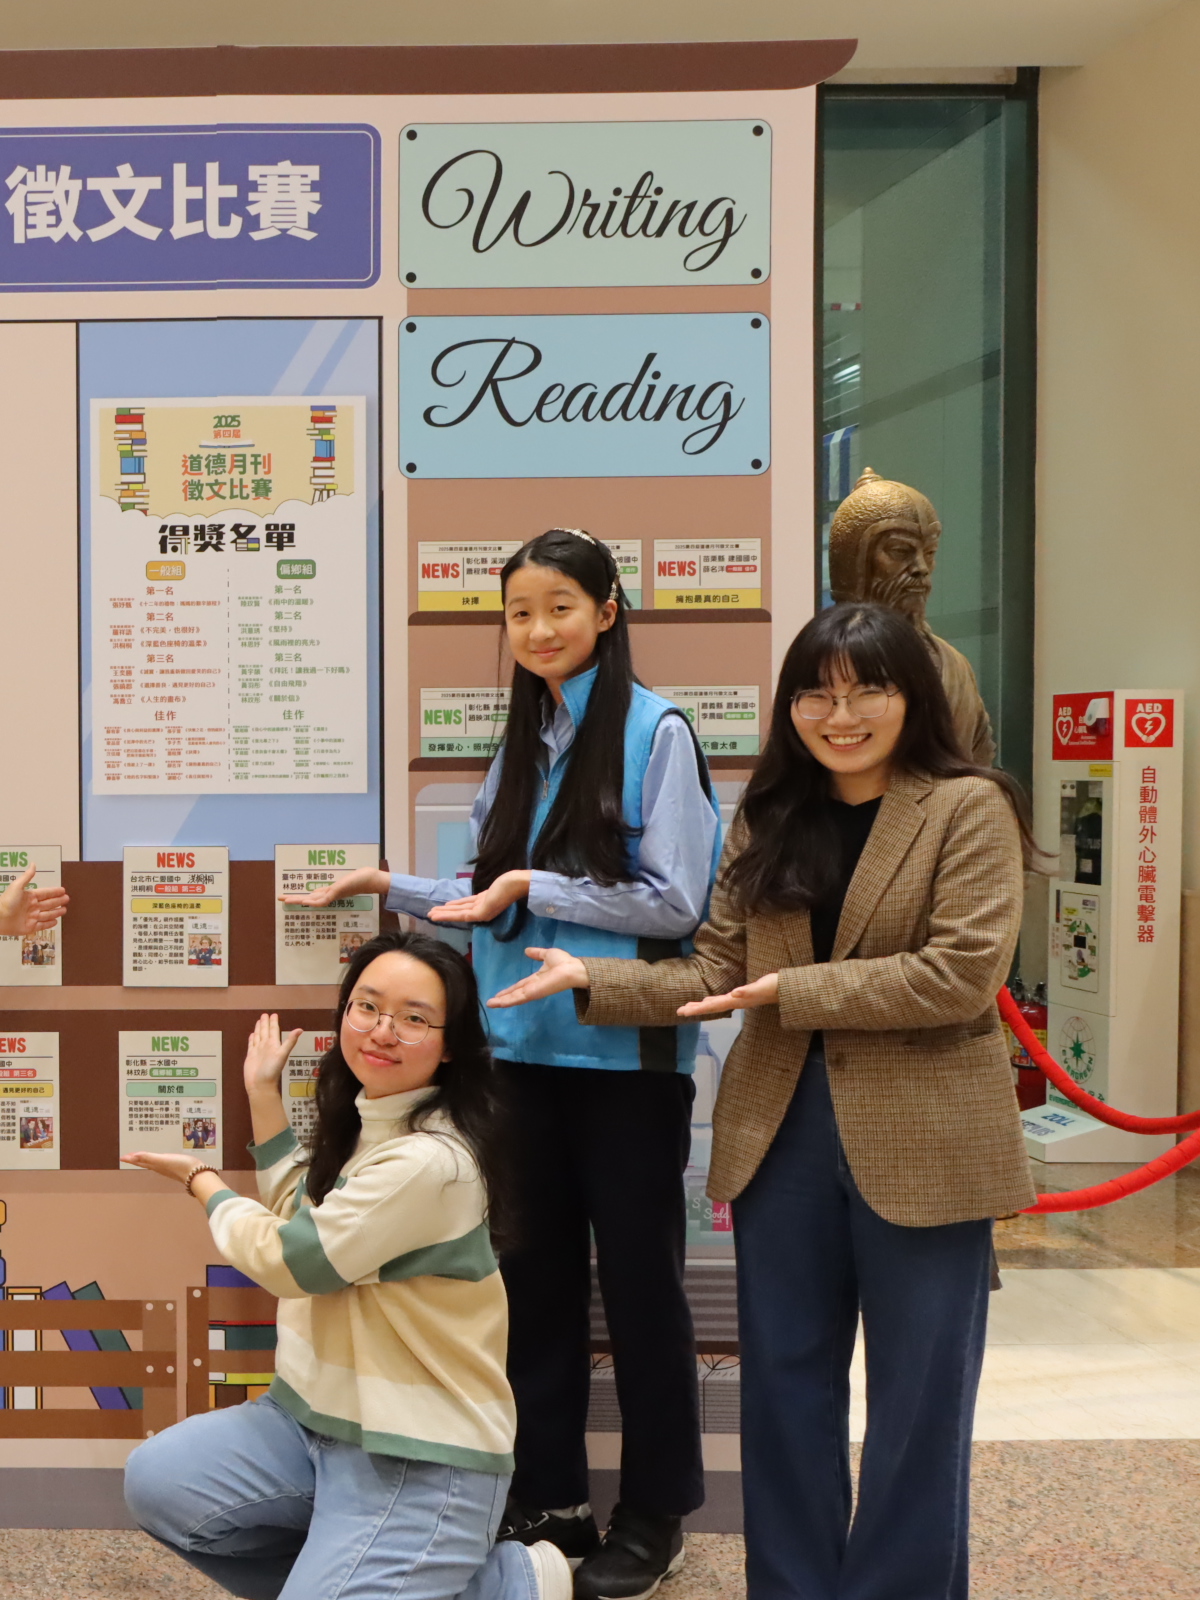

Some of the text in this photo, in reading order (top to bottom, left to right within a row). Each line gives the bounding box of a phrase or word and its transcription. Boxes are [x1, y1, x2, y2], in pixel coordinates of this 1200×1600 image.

[5, 161, 322, 244] 徵文比賽
[421, 149, 747, 271] Writing
[423, 337, 745, 455] Reading
[213, 415, 241, 428] 2025
[213, 429, 241, 439] 第四屆
[181, 453, 272, 475] 道德月刊
[182, 478, 272, 501] 徵文比賽
[158, 523, 296, 554] 得獎名單
[149, 565, 182, 576] 一般組
[280, 563, 313, 575] 偏鄉組
[421, 563, 460, 579] NEWS
[657, 561, 696, 577] NEWS
[146, 586, 174, 596] 第一名
[274, 585, 302, 594] 第一名
[676, 595, 739, 603] 擁抱最真的自己
[146, 612, 174, 621] 第二名
[274, 611, 302, 620] 第二名
[146, 654, 174, 663] 第三名
[274, 653, 302, 662] 第三名
[1058, 707, 1072, 716] AED
[1135, 703, 1163, 713] AED
[154, 710, 177, 721] 佳作
[282, 709, 305, 720] 佳作
[424, 709, 462, 725] NEWS
[156, 852, 195, 868] NEWS
[308, 850, 346, 866] NEWS
[1137, 766, 1158, 943] 自動體外心臟電擊器
[151, 1036, 190, 1052] NEWS
[314, 1036, 337, 1052] NE
[158, 1085, 184, 1094] 關於信
